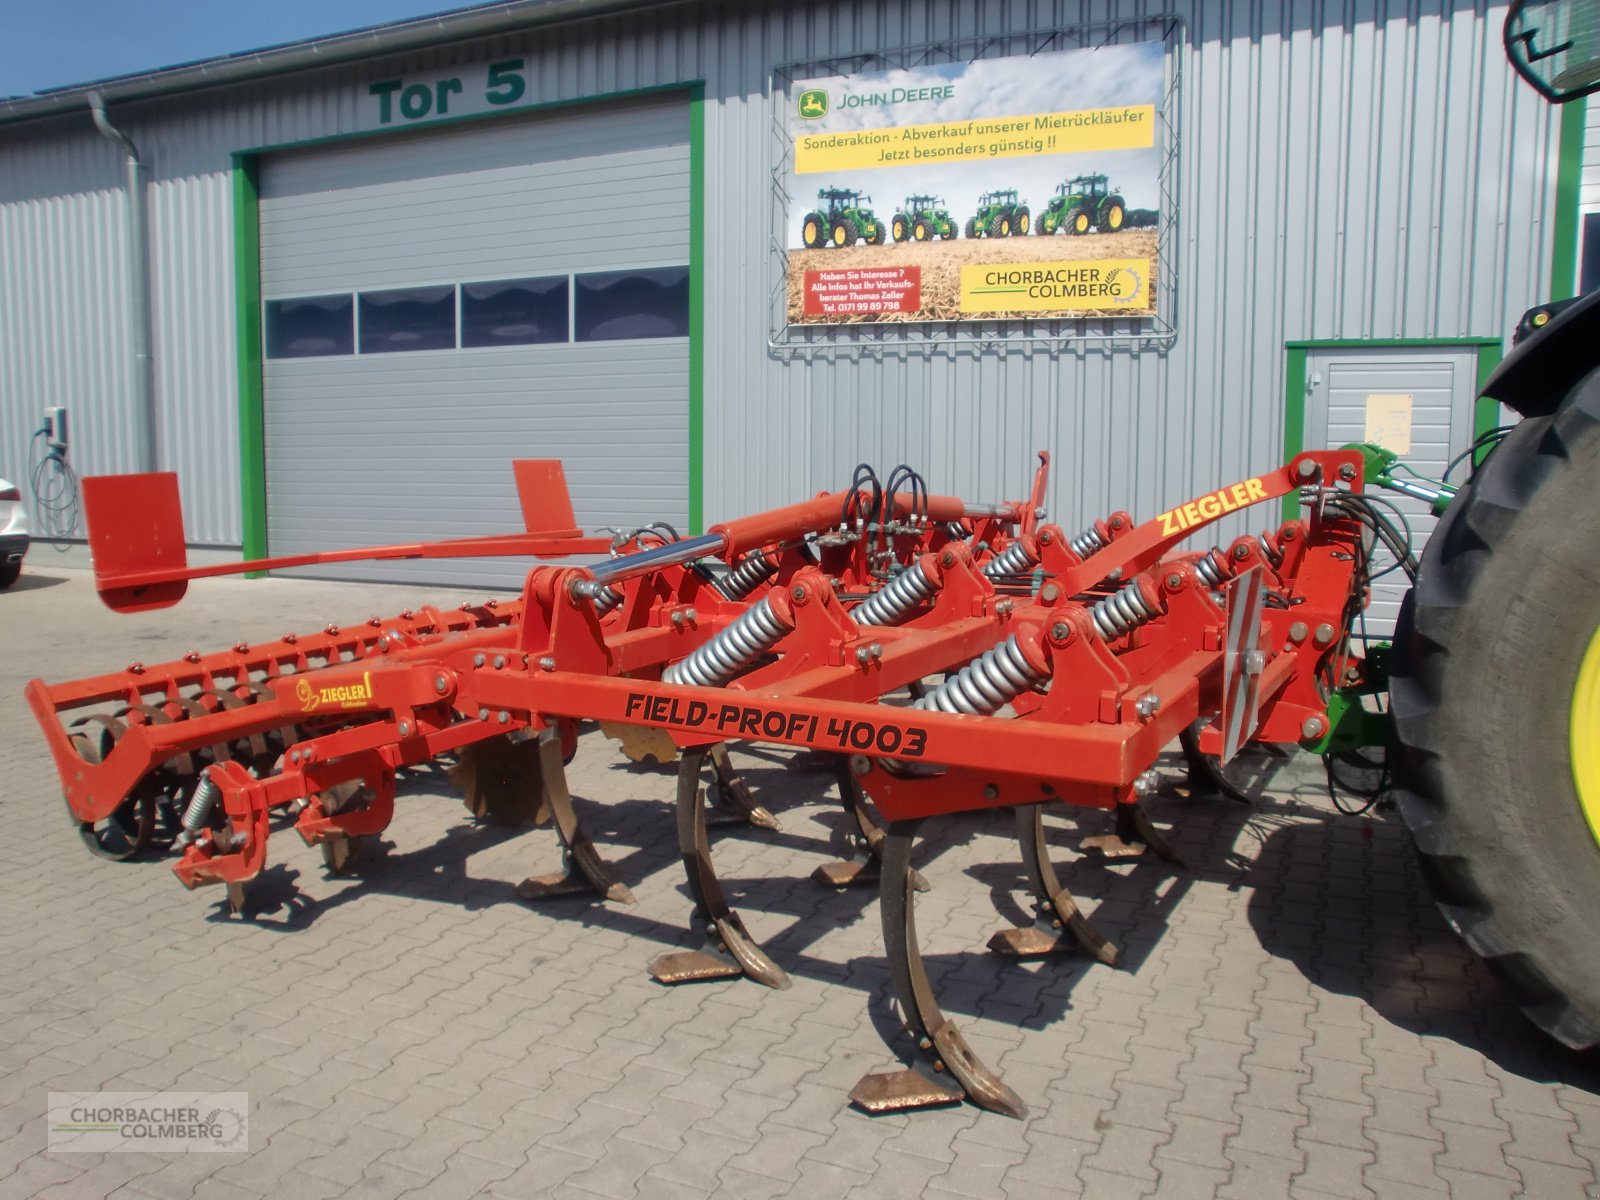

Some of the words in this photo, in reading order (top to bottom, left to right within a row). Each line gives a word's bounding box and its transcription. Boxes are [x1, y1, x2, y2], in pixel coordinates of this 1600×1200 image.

[368, 77, 463, 124] Tor
[485, 58, 526, 105] 5
[836, 92, 887, 110] JOHN
[892, 85, 956, 104] DEERE
[804, 132, 890, 150] Sonderaktion
[902, 122, 973, 141] Abverkauf
[976, 121, 1031, 135] unserer
[1034, 109, 1145, 130] Mietrückläufer
[878, 148, 910, 162] Jetzt
[913, 142, 986, 159] besonders
[989, 137, 1043, 156] günstig
[1047, 135, 1056, 148] !!
[811, 283, 827, 291] Alle
[828, 281, 848, 291] Infos
[849, 281, 862, 290] hat
[863, 280, 875, 288] Ihr
[876, 279, 914, 288] Verkaufs-
[820, 272, 845, 281] Haben
[847, 271, 860, 279] Sie
[861, 270, 898, 279] Interesse
[985, 268, 1100, 286] CHORBACHER
[819, 293, 848, 301] berater
[849, 292, 880, 301] Thomas
[881, 291, 904, 299] Zeller
[1028, 282, 1121, 299] COLMBERG
[823, 303, 836, 312] Tel.
[838, 302, 855, 311] 0171
[857, 302, 868, 311] 99
[870, 302, 881, 310] 89
[883, 301, 900, 310] 798
[1157, 478, 1268, 537] ZIEGLER
[320, 684, 366, 703] ZIEGLER
[624, 693, 820, 743] FIELD-PROFI
[826, 718, 929, 757] 4003
